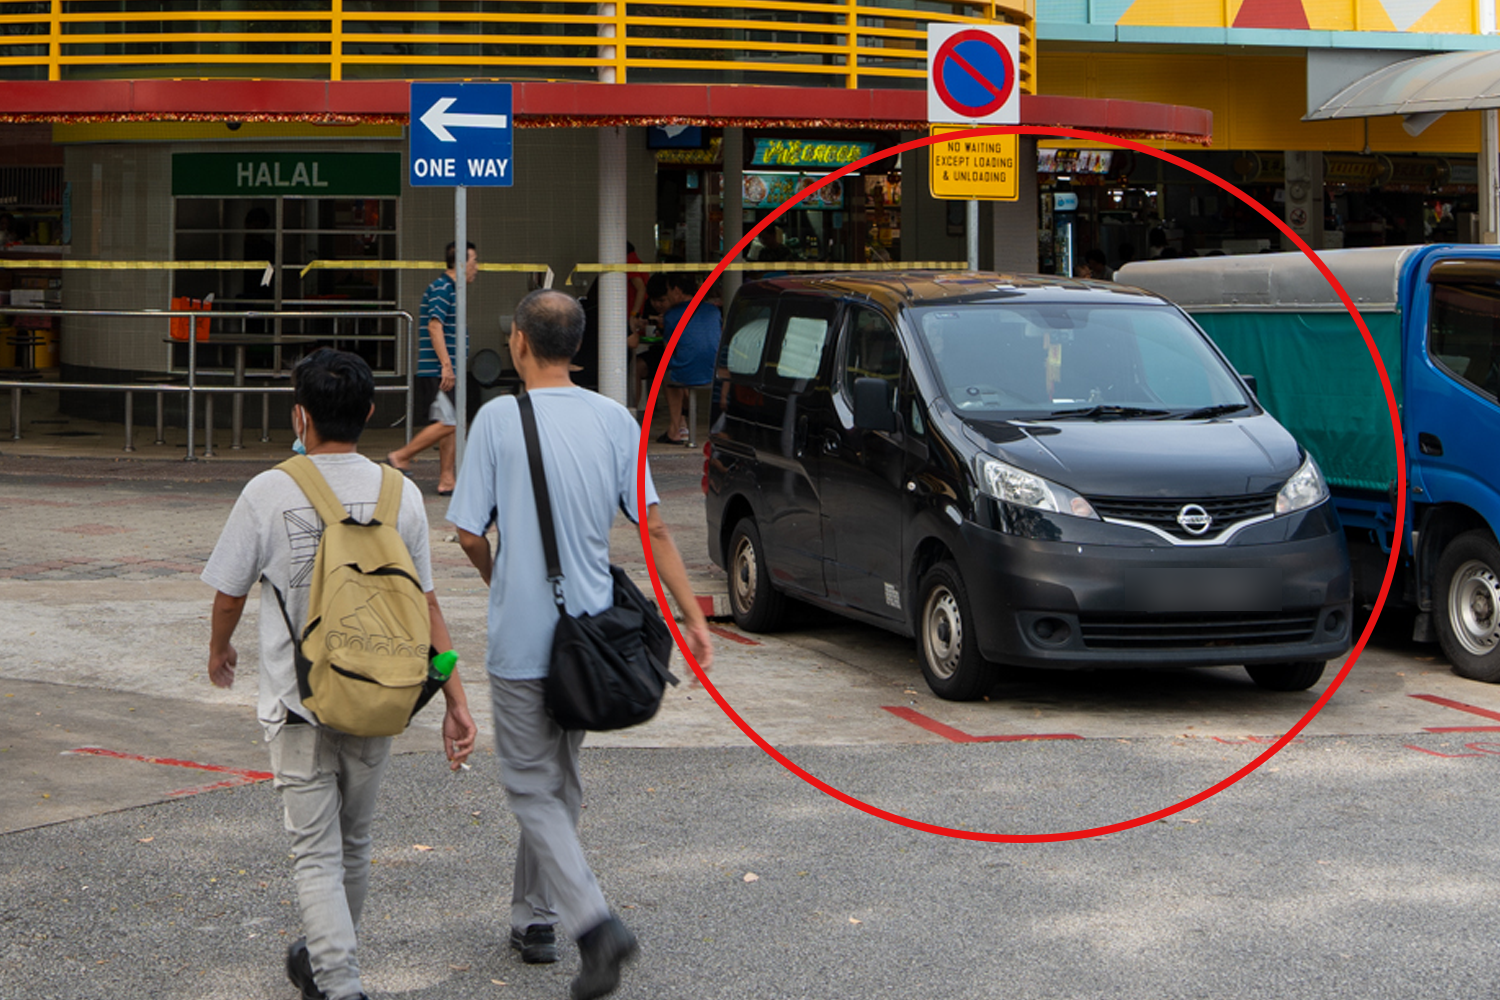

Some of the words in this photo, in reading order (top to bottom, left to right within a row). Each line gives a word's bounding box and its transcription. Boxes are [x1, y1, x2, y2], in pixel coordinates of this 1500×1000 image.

[947, 142, 961, 153] NO
[964, 142, 1002, 154] WAITING
[414, 158, 457, 178] ONE
[467, 158, 509, 178] WAY
[935, 155, 970, 167] EXCEPT
[973, 156, 1014, 169] LOADING
[237, 162, 329, 187] HALAL
[942, 170, 950, 181] &
[953, 170, 1007, 183] UNLOADING
